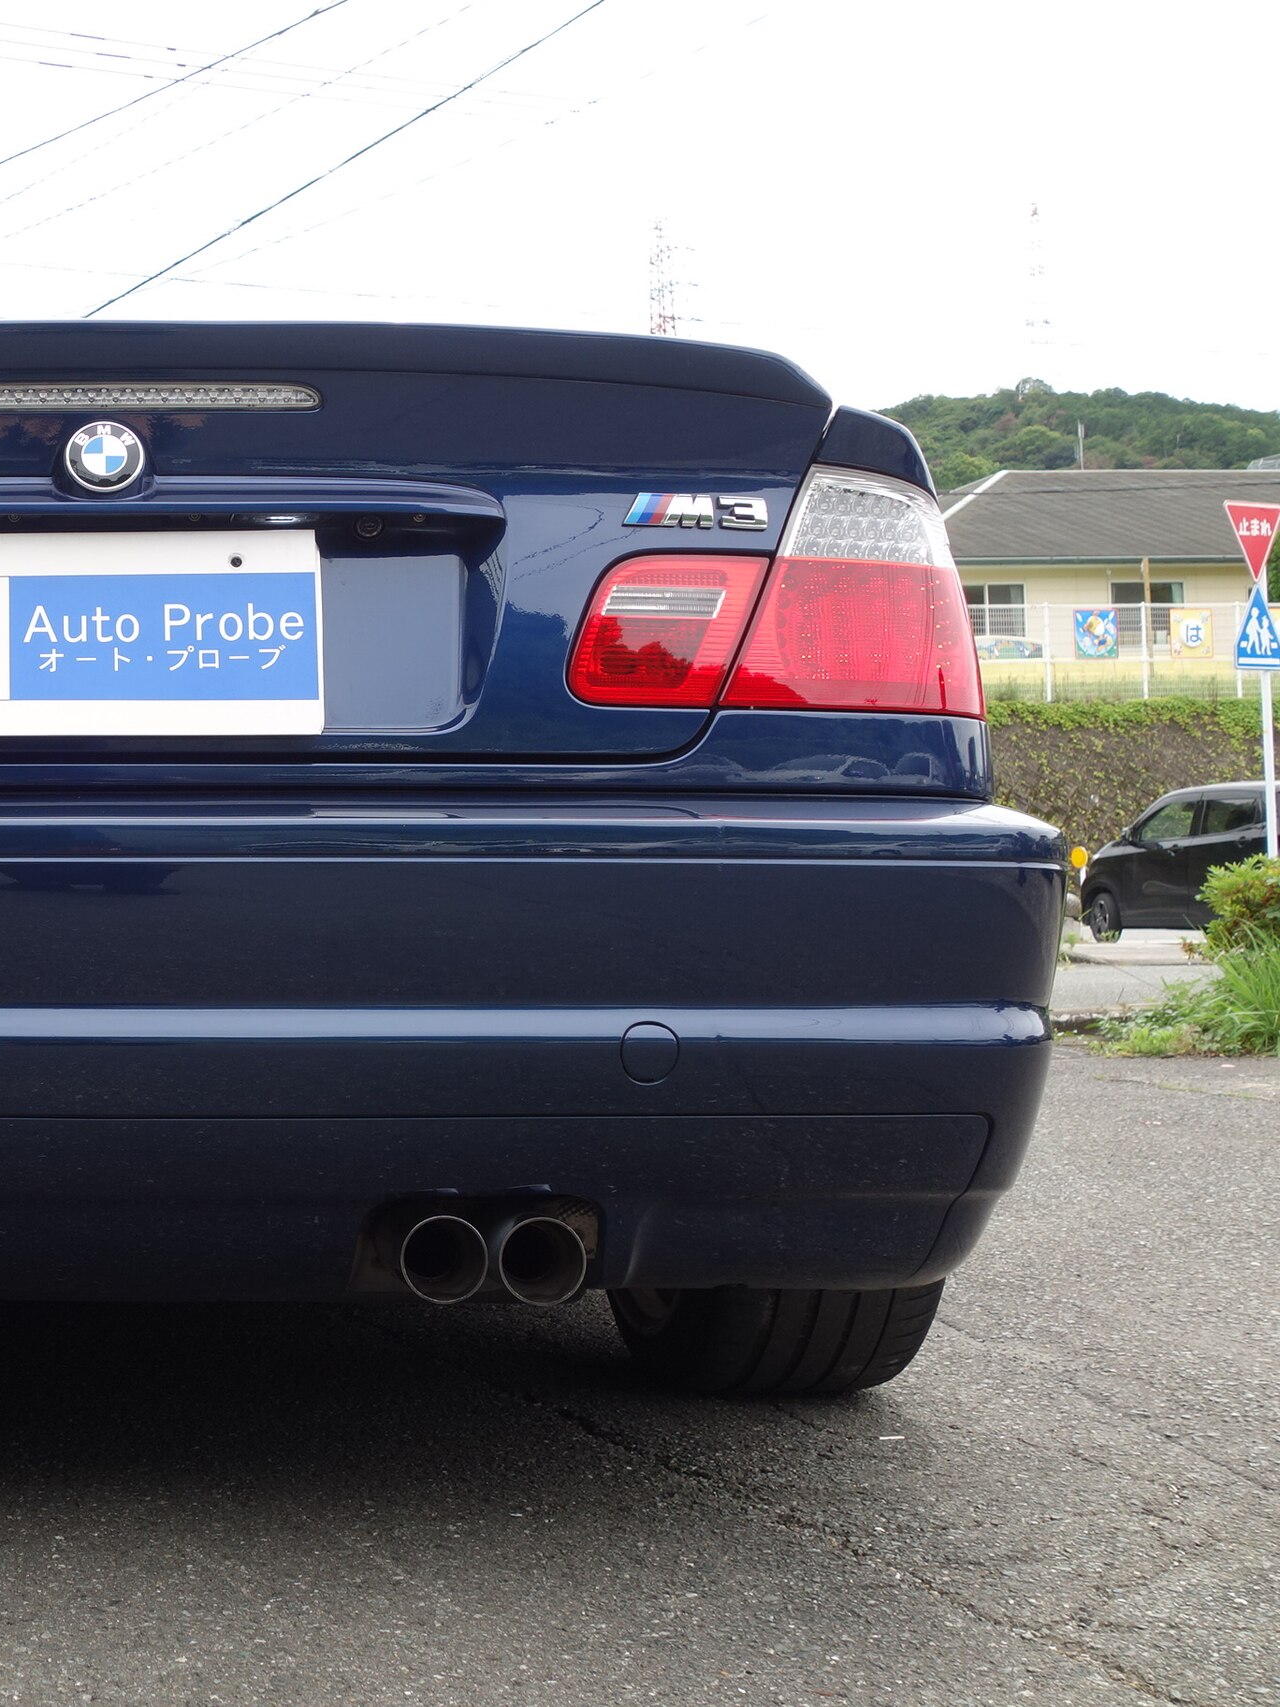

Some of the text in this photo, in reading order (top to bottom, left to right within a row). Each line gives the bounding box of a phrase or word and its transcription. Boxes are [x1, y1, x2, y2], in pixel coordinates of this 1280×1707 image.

[73, 424, 136, 447] BMW
[657, 493, 768, 530] M3
[1238, 516, 1272, 537] 止まれ
[23, 602, 305, 643] Auto Probe
[38, 644, 287, 673] オート・プローブ
